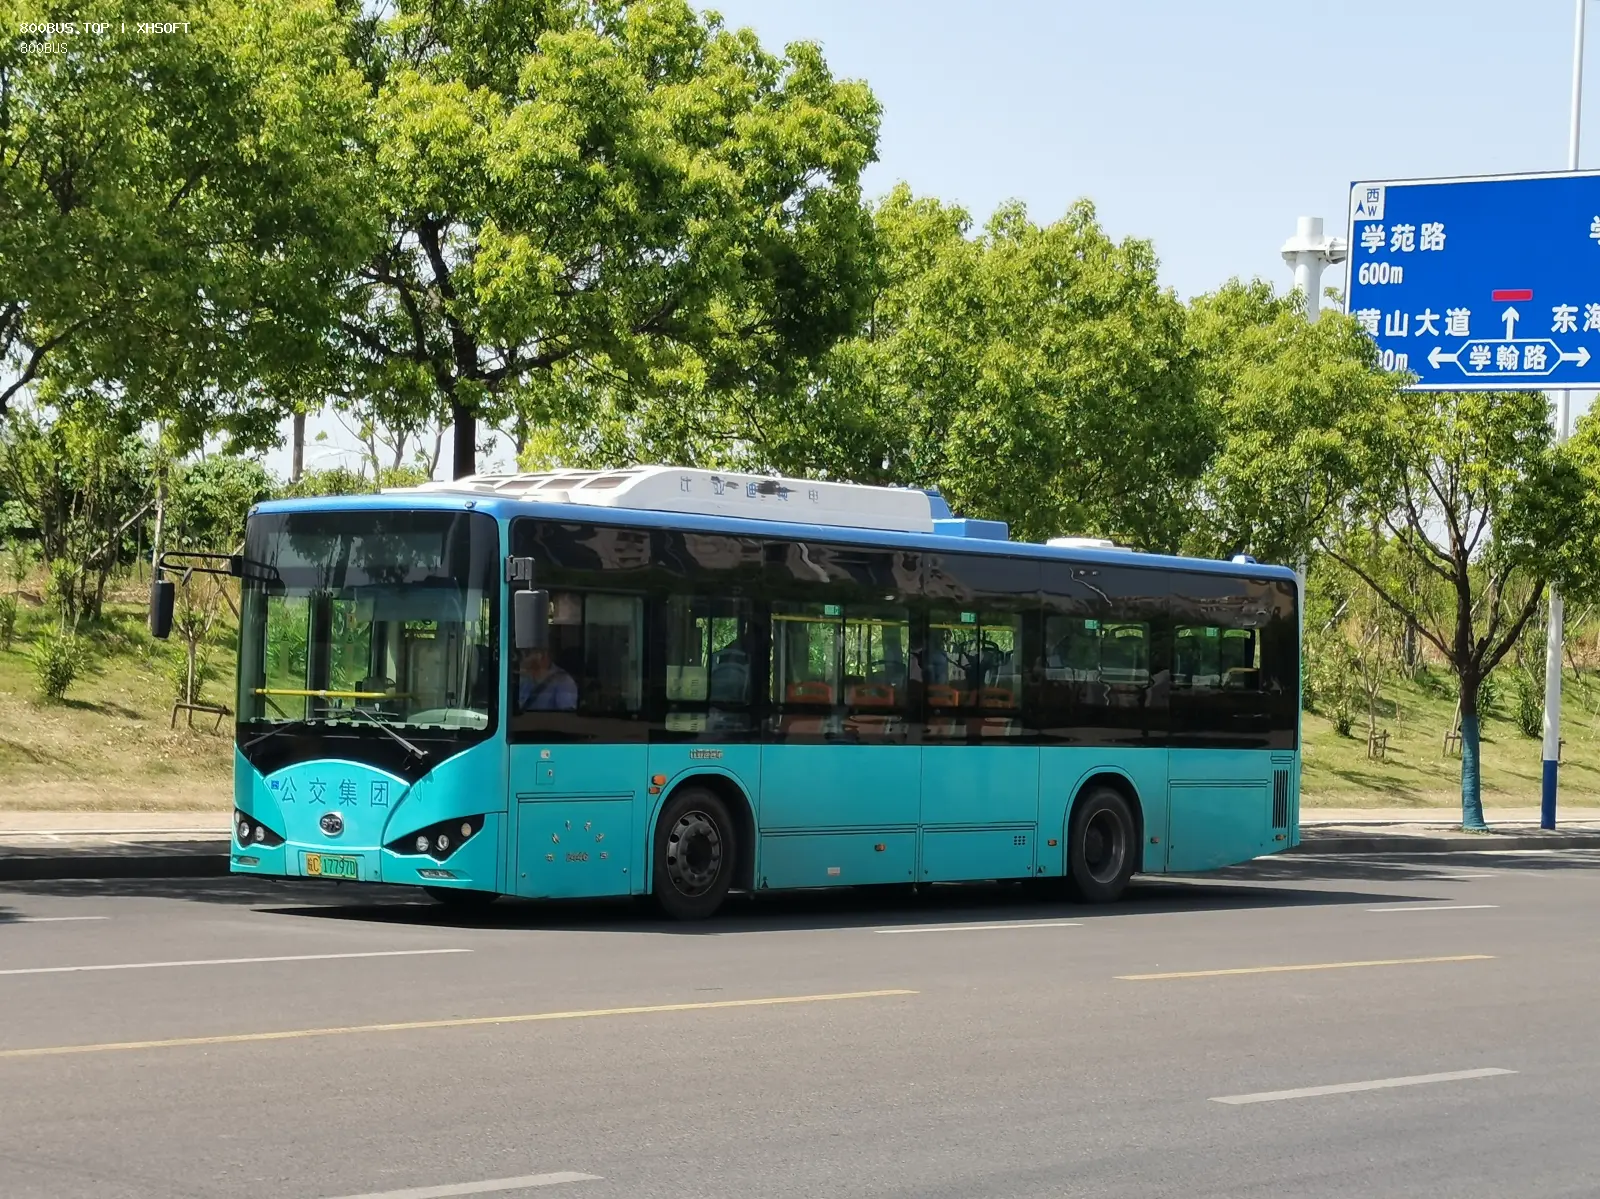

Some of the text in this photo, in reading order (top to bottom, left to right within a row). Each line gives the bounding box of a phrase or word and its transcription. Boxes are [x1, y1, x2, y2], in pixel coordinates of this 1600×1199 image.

[1366, 188, 1380, 203] 西
[1367, 205, 1378, 217] W
[1360, 221, 1447, 254] 学苑路
[1358, 261, 1404, 285] 600m
[1356, 307, 1471, 337] 黄山大道
[1468, 344, 1548, 371] 学翰路
[279, 776, 389, 808] 公交集团
